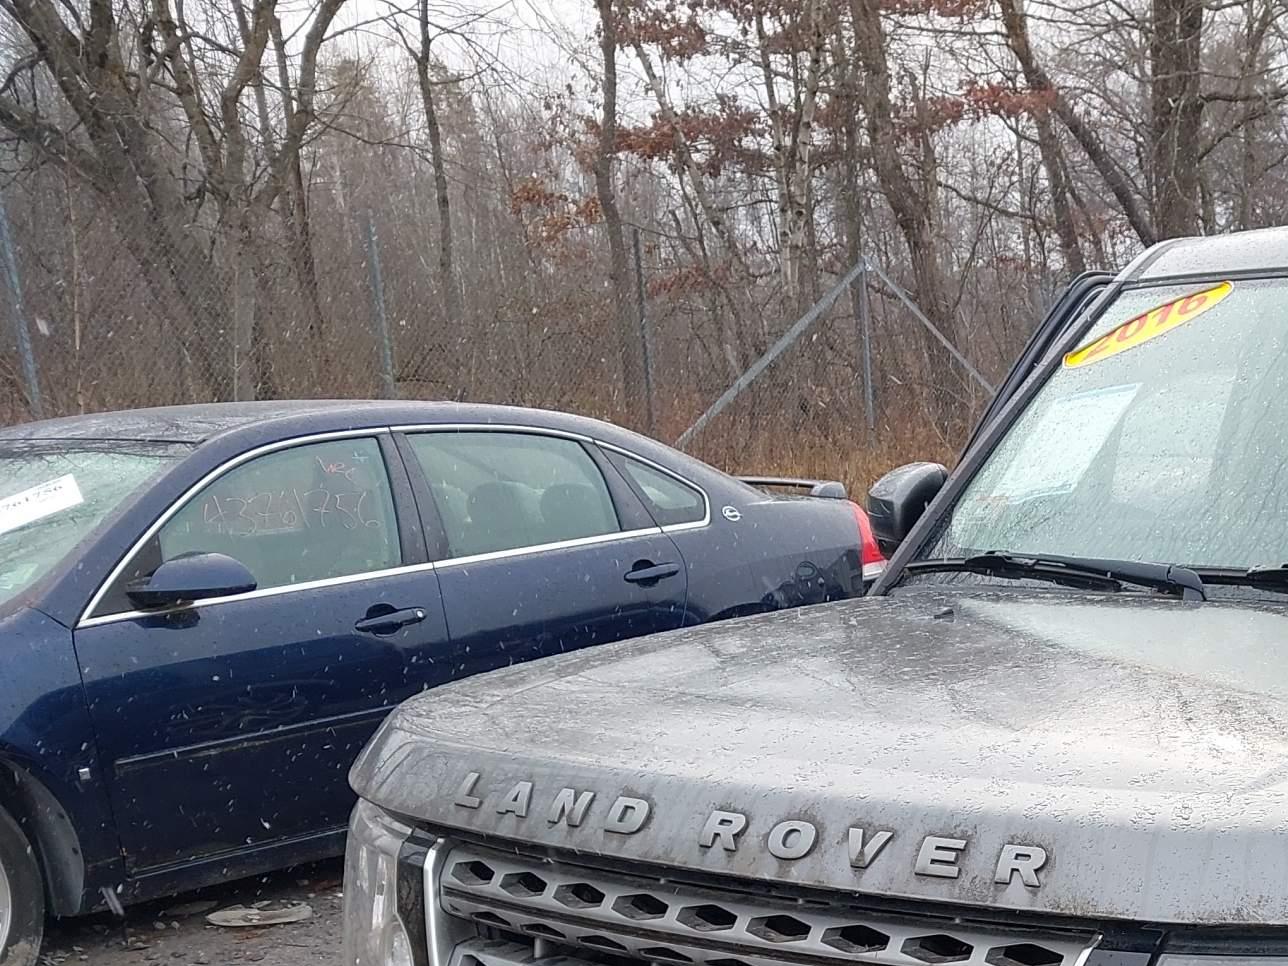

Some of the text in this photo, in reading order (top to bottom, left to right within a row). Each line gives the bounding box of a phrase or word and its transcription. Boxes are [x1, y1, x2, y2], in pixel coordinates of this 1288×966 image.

[1081, 294, 1208, 362] 2016
[454, 771, 1047, 888] LAND ROVER
